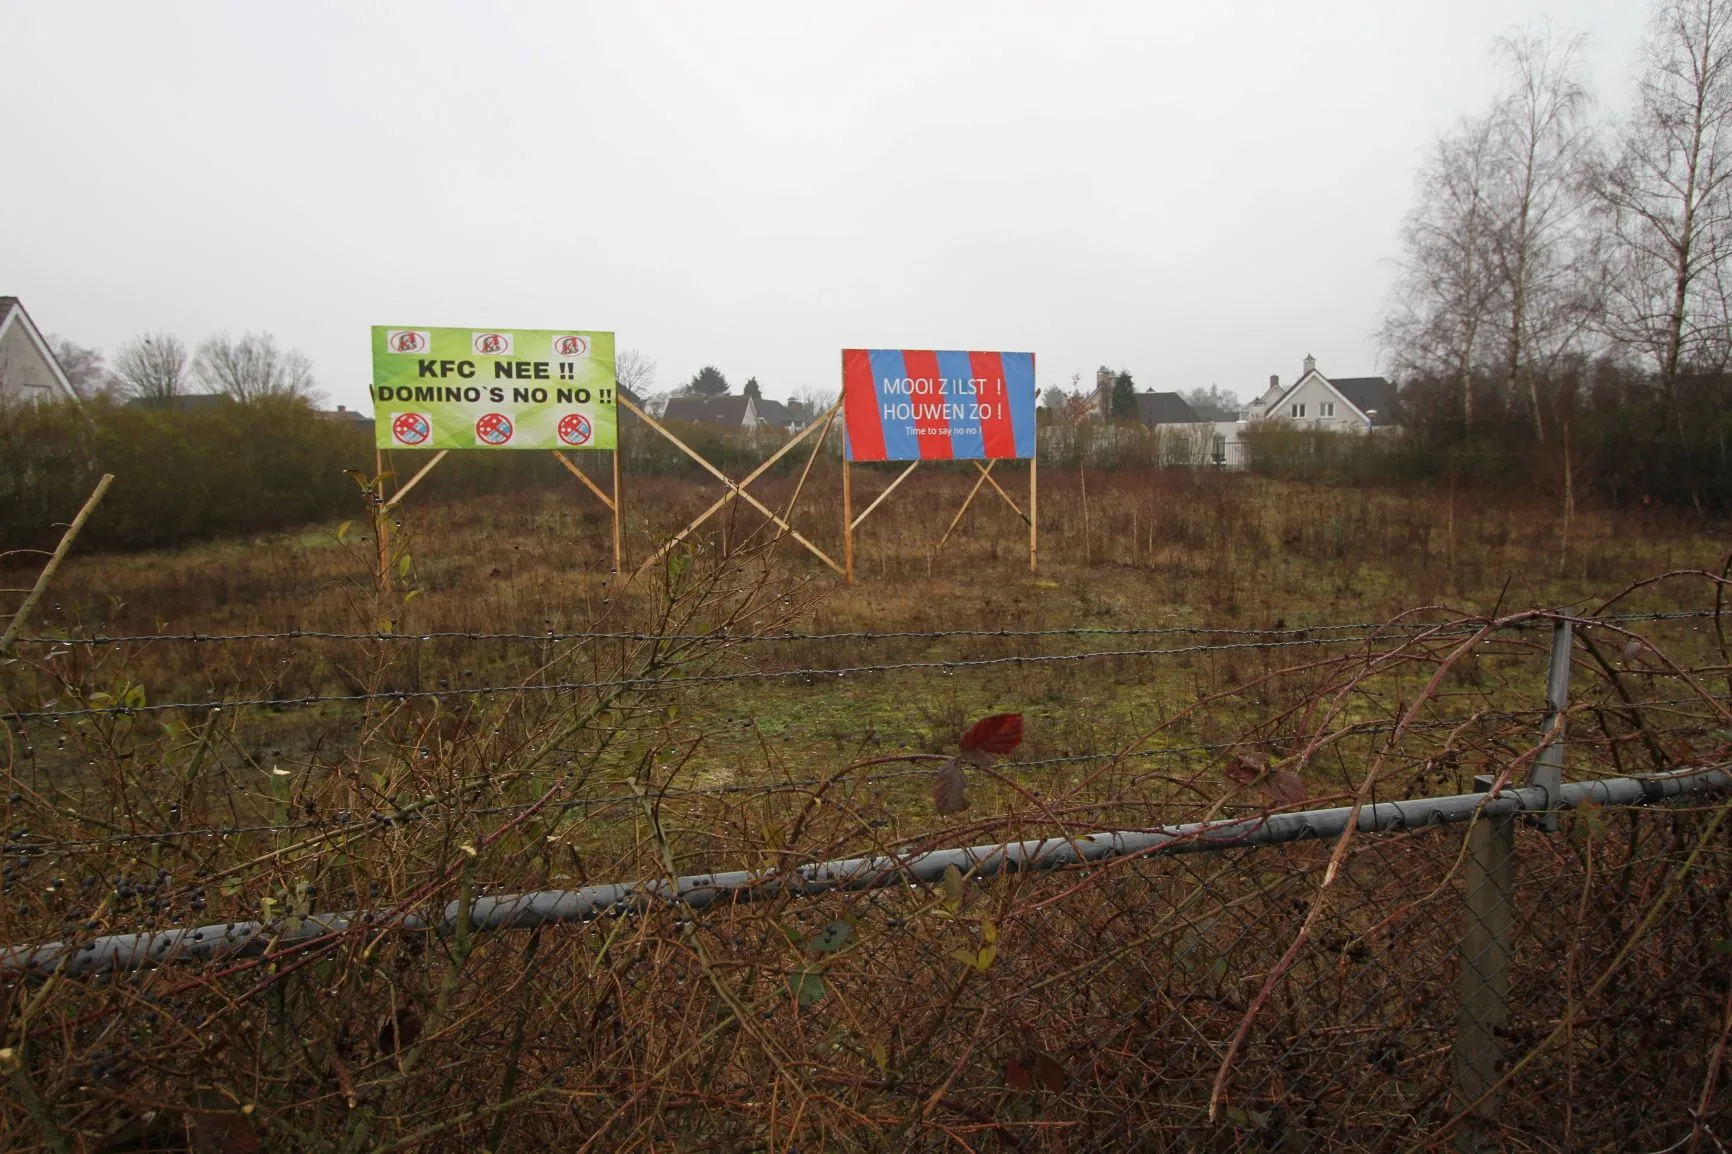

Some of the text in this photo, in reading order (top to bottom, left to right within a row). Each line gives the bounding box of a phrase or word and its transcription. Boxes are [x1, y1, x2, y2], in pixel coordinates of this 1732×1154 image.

[418, 359, 574, 380] KFC NEE !!
[883, 377, 933, 395] MOOI
[513, 387, 548, 404] NO
[556, 388, 591, 404] NO
[599, 388, 612, 404] !!
[883, 403, 965, 420] HOUWEN
[969, 403, 992, 420] ZO
[904, 426, 926, 436] Time
[927, 427, 937, 436] to
[938, 427, 952, 437] say
[953, 427, 965, 435] no
[966, 427, 977, 435] no
